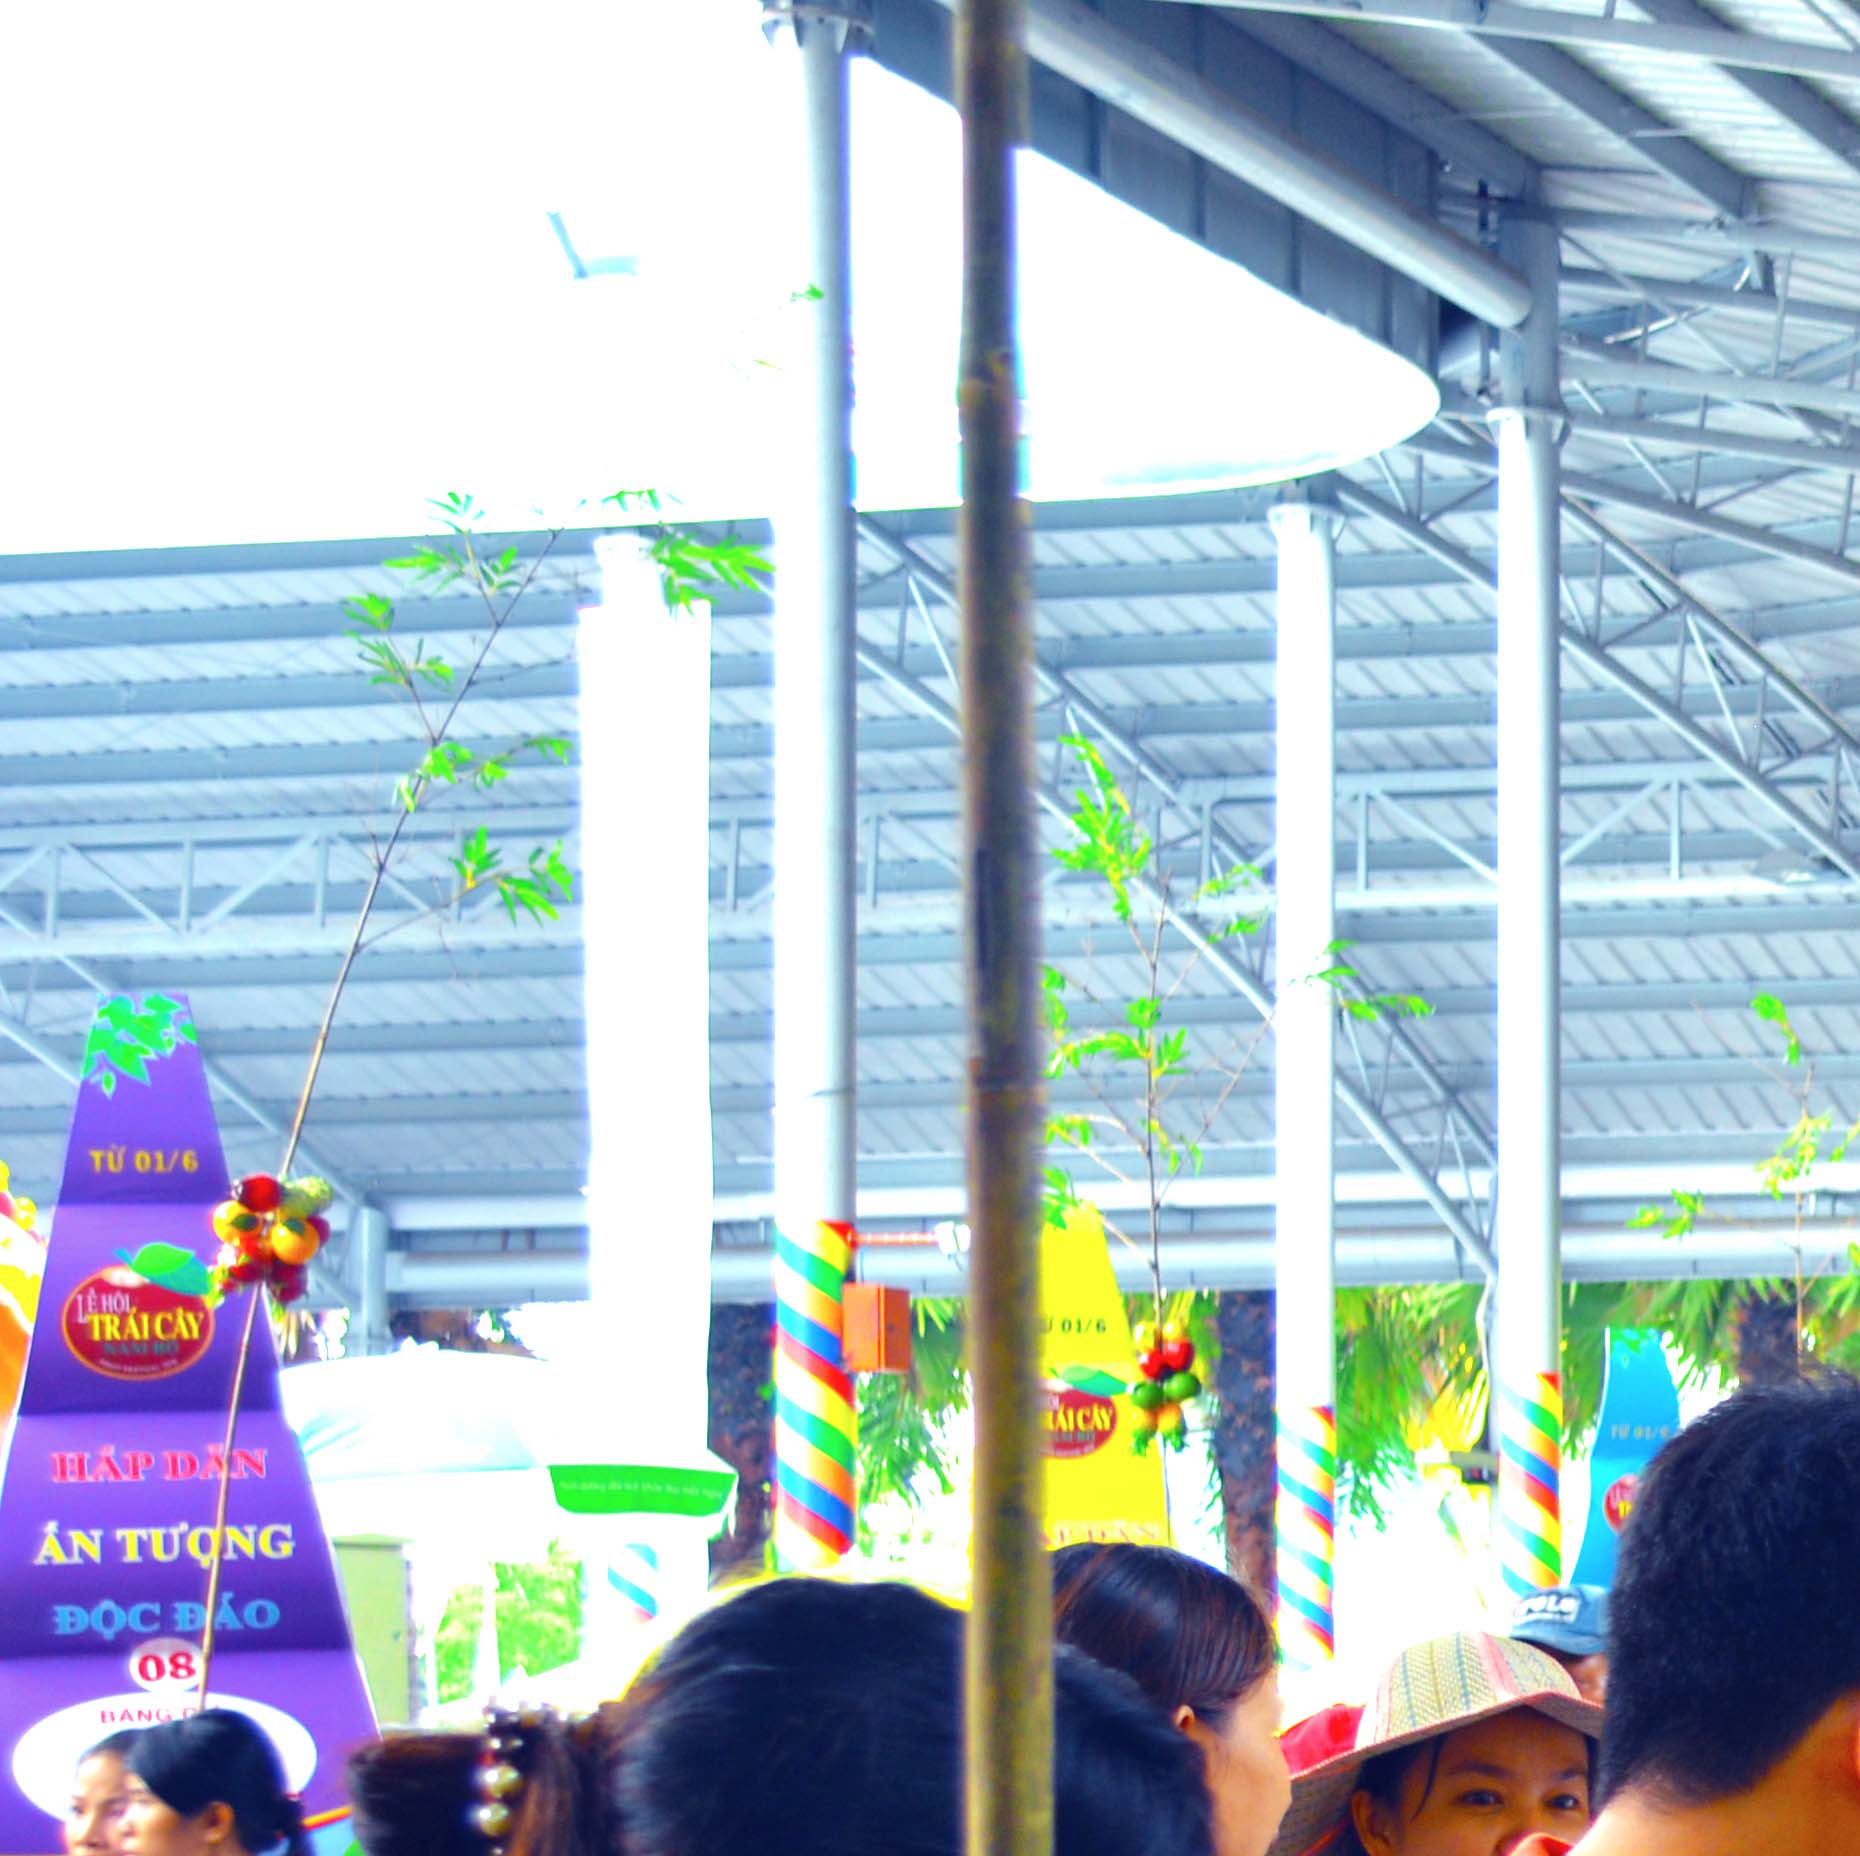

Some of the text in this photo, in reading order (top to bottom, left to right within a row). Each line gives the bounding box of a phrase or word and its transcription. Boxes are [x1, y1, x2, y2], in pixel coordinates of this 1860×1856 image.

[134, 1148, 199, 1173] 01/6
[87, 1306, 205, 1341] TRÁI CÂY
[52, 1443, 155, 1482] HẤP
[115, 1520, 295, 1569] TƯỢNG
[52, 1591, 280, 1640] ĐỘC ĐÁO
[137, 1650, 196, 1682] 08
